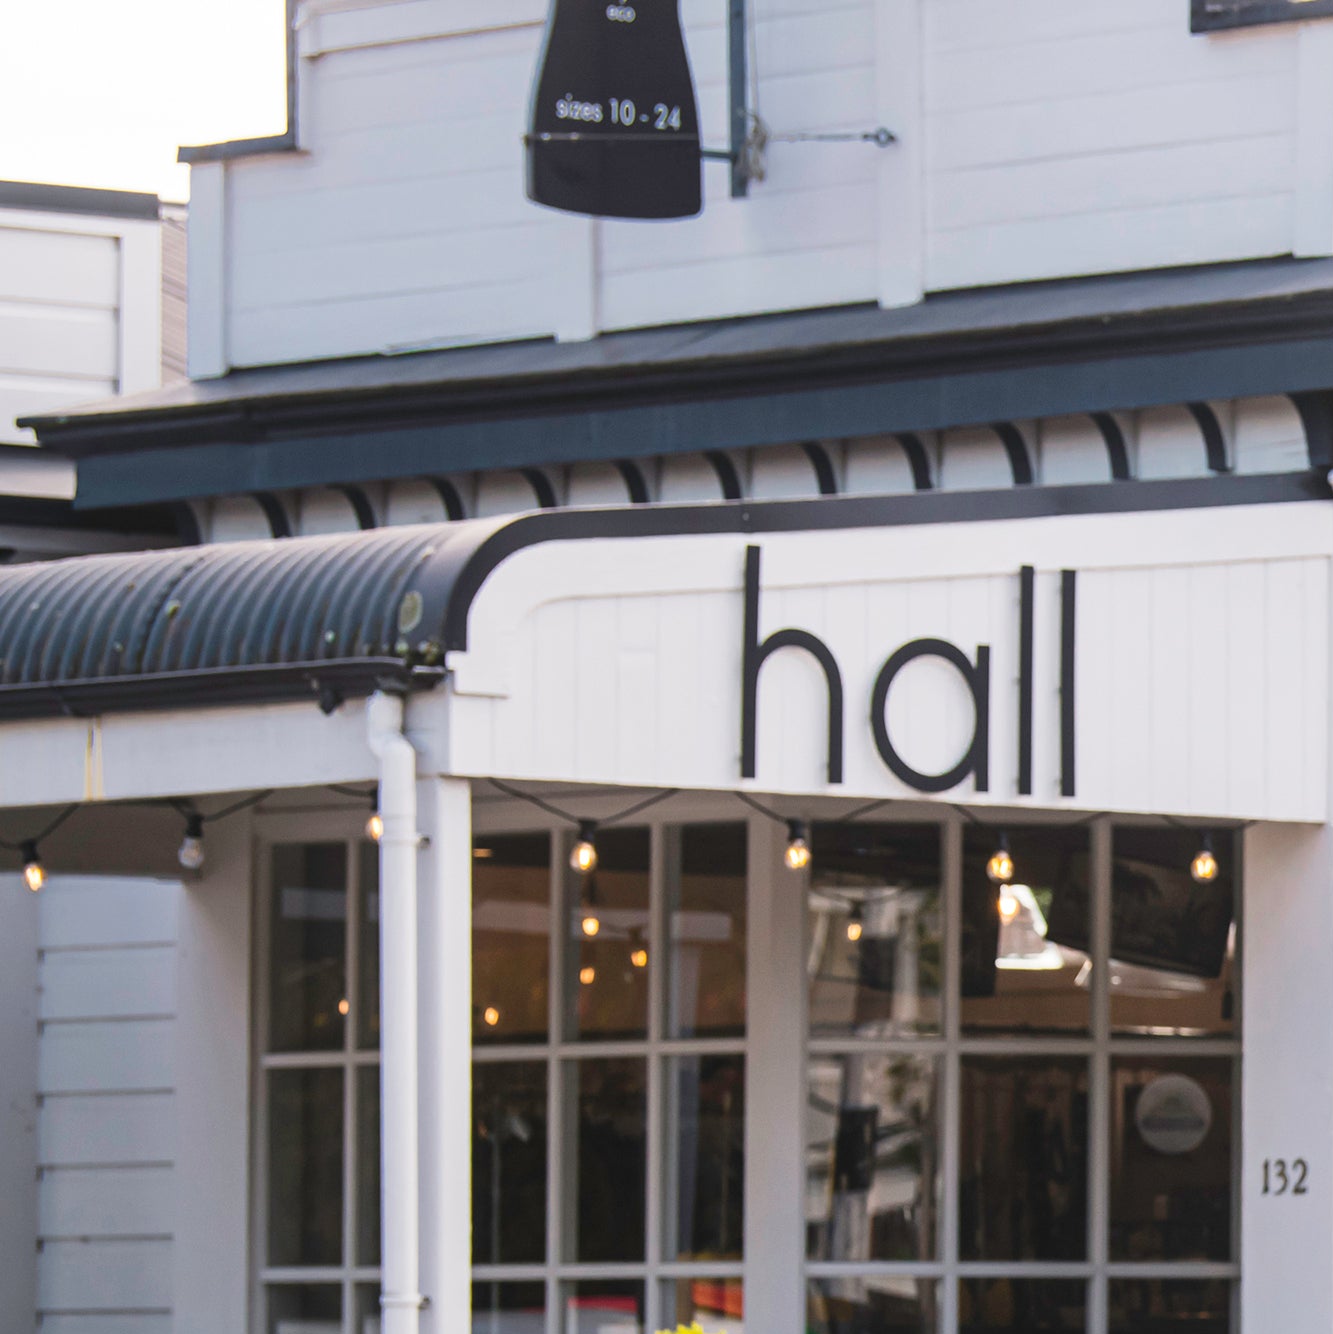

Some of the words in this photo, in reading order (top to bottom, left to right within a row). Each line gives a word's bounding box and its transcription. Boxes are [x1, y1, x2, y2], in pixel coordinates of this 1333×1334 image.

[556, 92, 603, 122] sizes
[608, 97, 635, 126] 10
[653, 102, 681, 131] 24
[741, 545, 1076, 797] hall
[1261, 1158, 1307, 1196] 132
